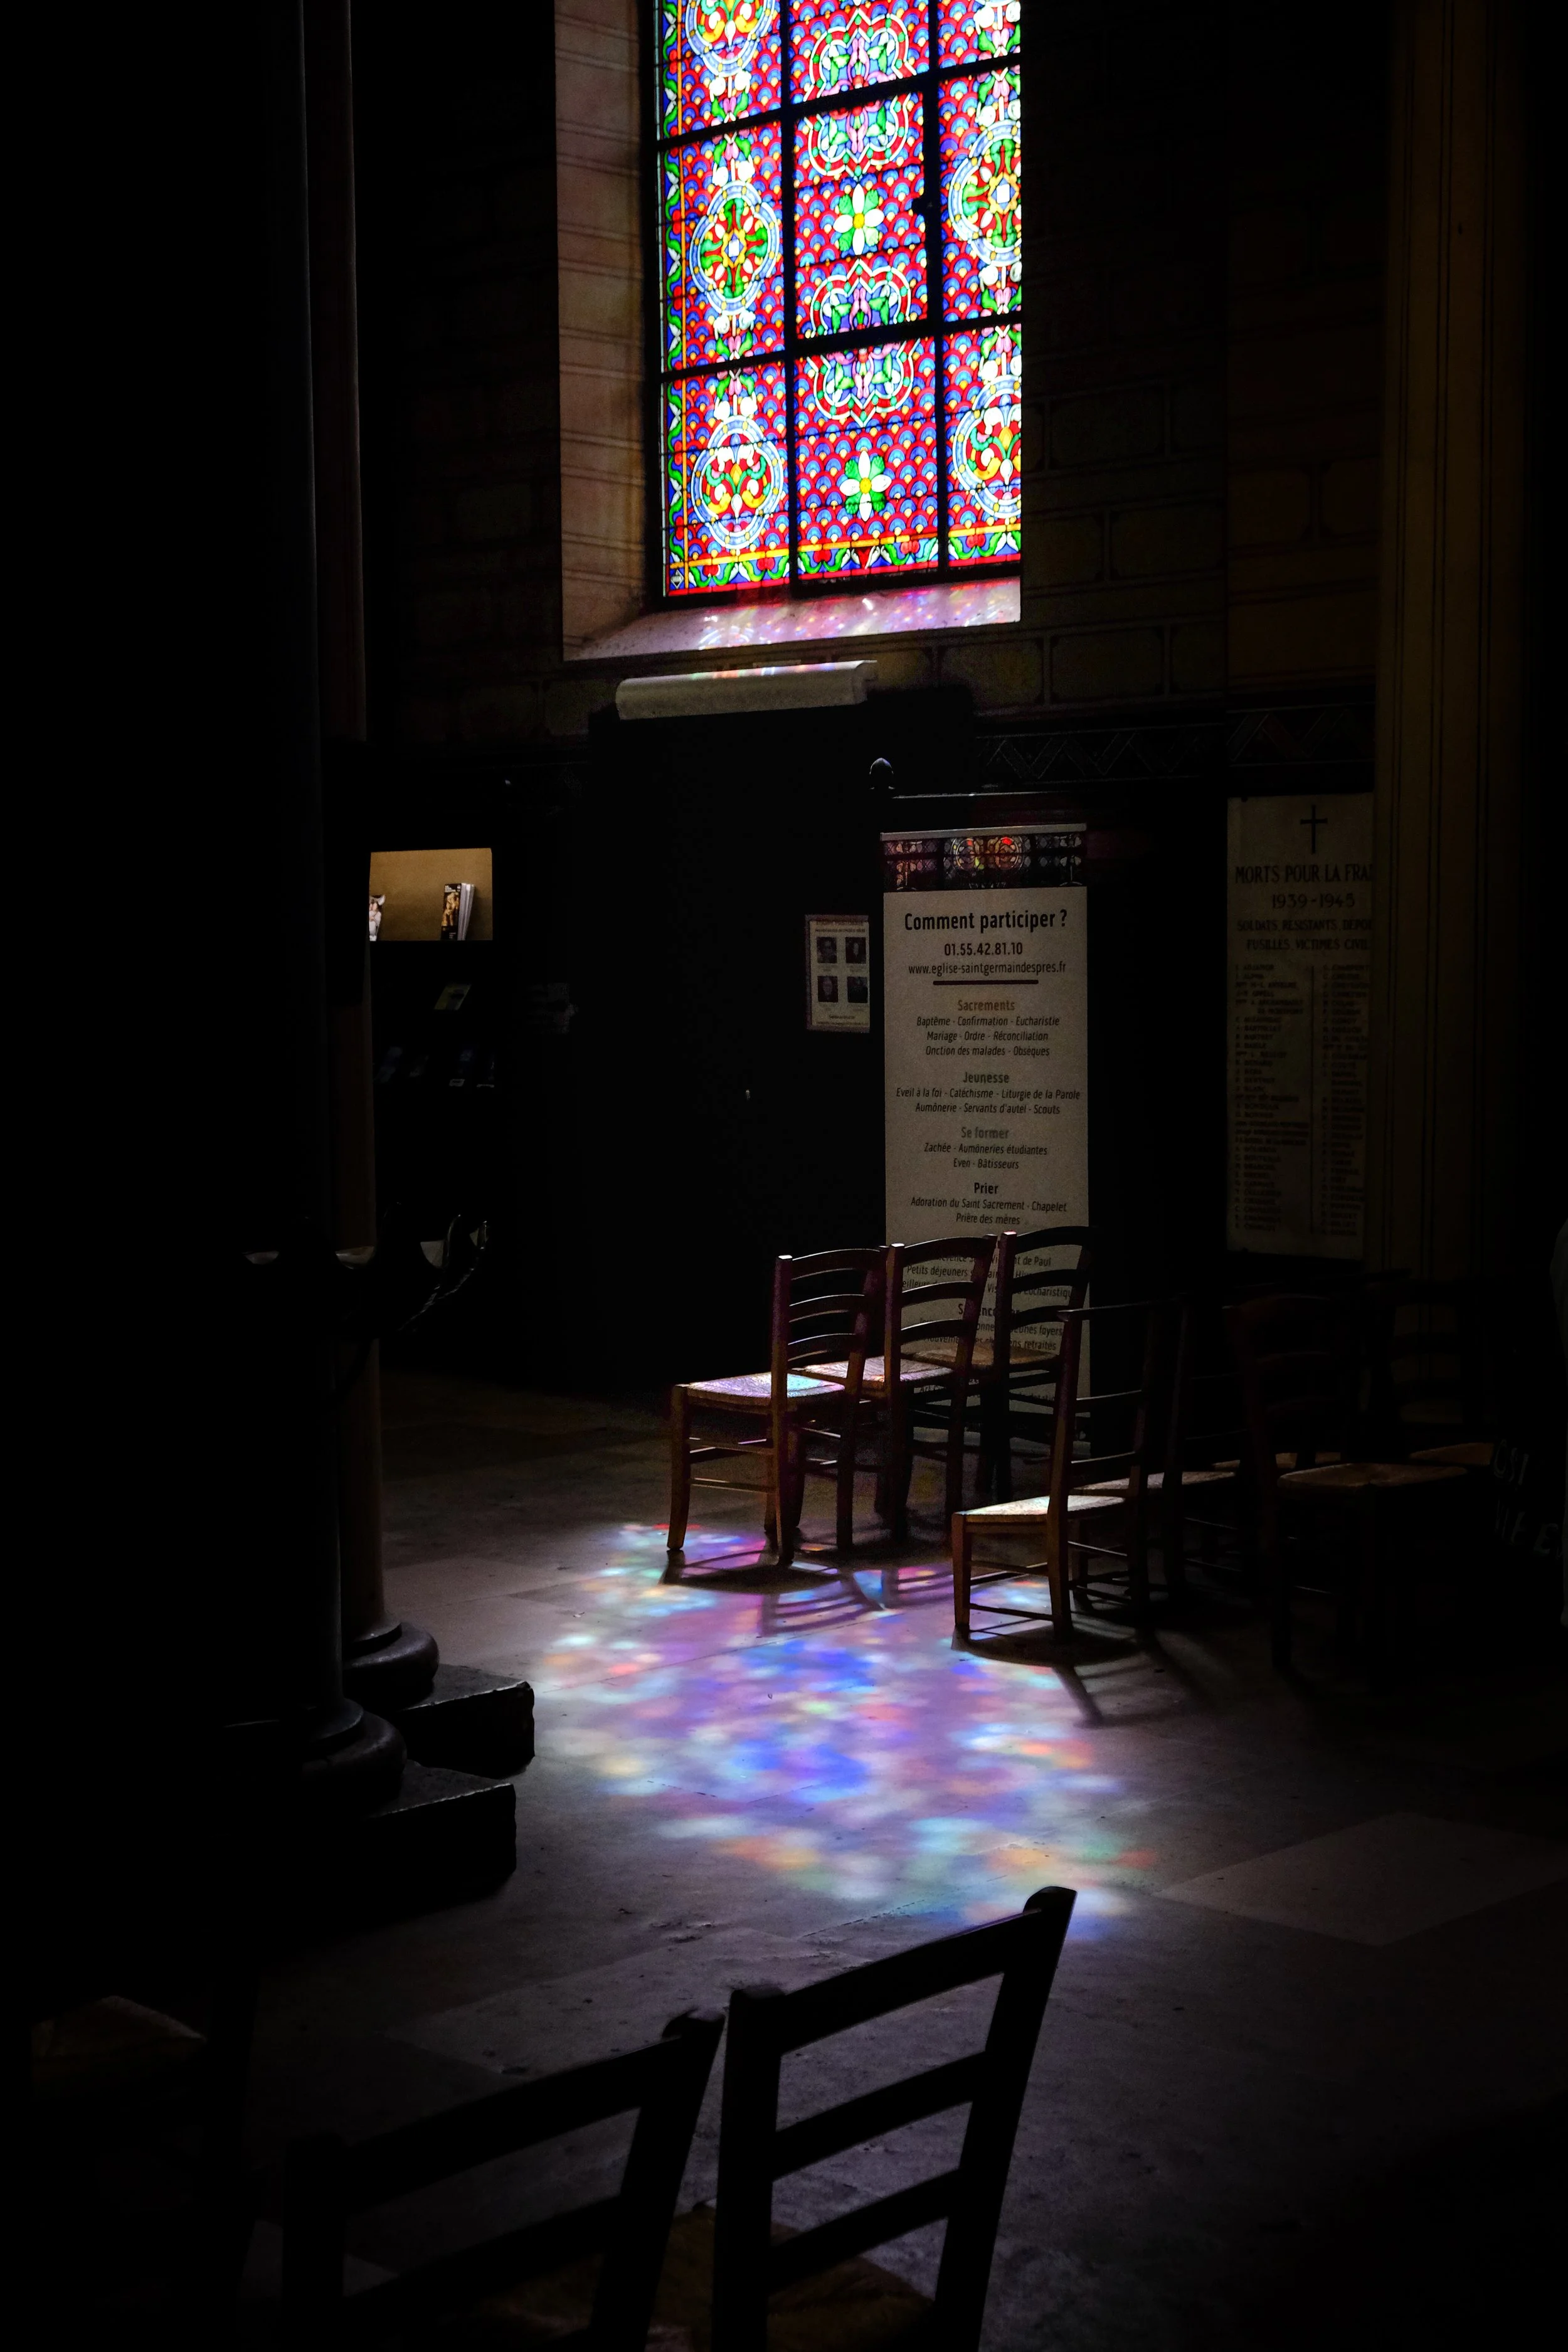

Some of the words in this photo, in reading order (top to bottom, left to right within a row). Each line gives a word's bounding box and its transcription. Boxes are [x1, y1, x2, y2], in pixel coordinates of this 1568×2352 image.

[1235, 866, 1279, 884] MORTS
[1285, 864, 1320, 882] POUR
[1325, 864, 1341, 882] LA
[1272, 893, 1355, 908] 1939-1945
[904, 913, 974, 931] Comment
[980, 910, 1055, 933] participer
[1060, 909, 1067, 927] ?
[945, 942, 1023, 956] 01.55.42.81.10
[908, 961, 1066, 977] www.eglise-saintgermaindespres.fr
[958, 1000, 1015, 1012] Sacrements
[917, 1016, 950, 1028] Baptême
[958, 1016, 1008, 1027] Confirmation
[1015, 1016, 1060, 1027] Eucharistie
[927, 1031, 957, 1043] Mariage
[964, 1031, 985, 1041] Ordre
[993, 1030, 1048, 1041] Réconciliation
[926, 1046, 955, 1056] Onction
[958, 1046, 970, 1056] des
[972, 1046, 1005, 1056] malades
[963, 1072, 1010, 1084] Jeunesse
[916, 1088, 921, 1097] à
[923, 1088, 930, 1097] la
[932, 1088, 942, 1097] foi
[950, 1088, 993, 1098] Catéchisme
[1002, 1089, 1031, 1101] Liturgie
[1033, 1089, 1042, 1099] de
[1046, 1089, 1052, 1099] la
[1056, 1089, 1081, 1099] Parole
[915, 1102, 956, 1112] Aumônerie
[963, 1103, 997, 1113] Servants
[999, 1103, 1027, 1113] d'autel
[1034, 1104, 1060, 1115] Scouts
[961, 1126, 972, 1138] Se
[975, 1127, 1009, 1139] former
[924, 1143, 951, 1153] Zachée
[958, 1143, 1004, 1154] Aumôneries
[1007, 1144, 1048, 1155] étudiantes
[953, 1158, 970, 1168] Even
[977, 1158, 1019, 1169] Bâtisseurs
[974, 1182, 999, 1194] Prier
[911, 1197, 947, 1207] Adoration
[950, 1198, 960, 1208] du
[961, 1199, 980, 1209] Saint
[983, 1199, 1025, 1210] Sacrement
[1032, 1201, 1067, 1214] Chapelet
[956, 1213, 977, 1223] Prière
[980, 1214, 993, 1224] des
[995, 1214, 1020, 1225] mères
[1023, 1256, 1032, 1265] de
[1034, 1256, 1052, 1267] Paul
[907, 1265, 928, 1275] Petits
[930, 1266, 968, 1278] déjeuners
[1039, 1325, 1062, 1337] foyers
